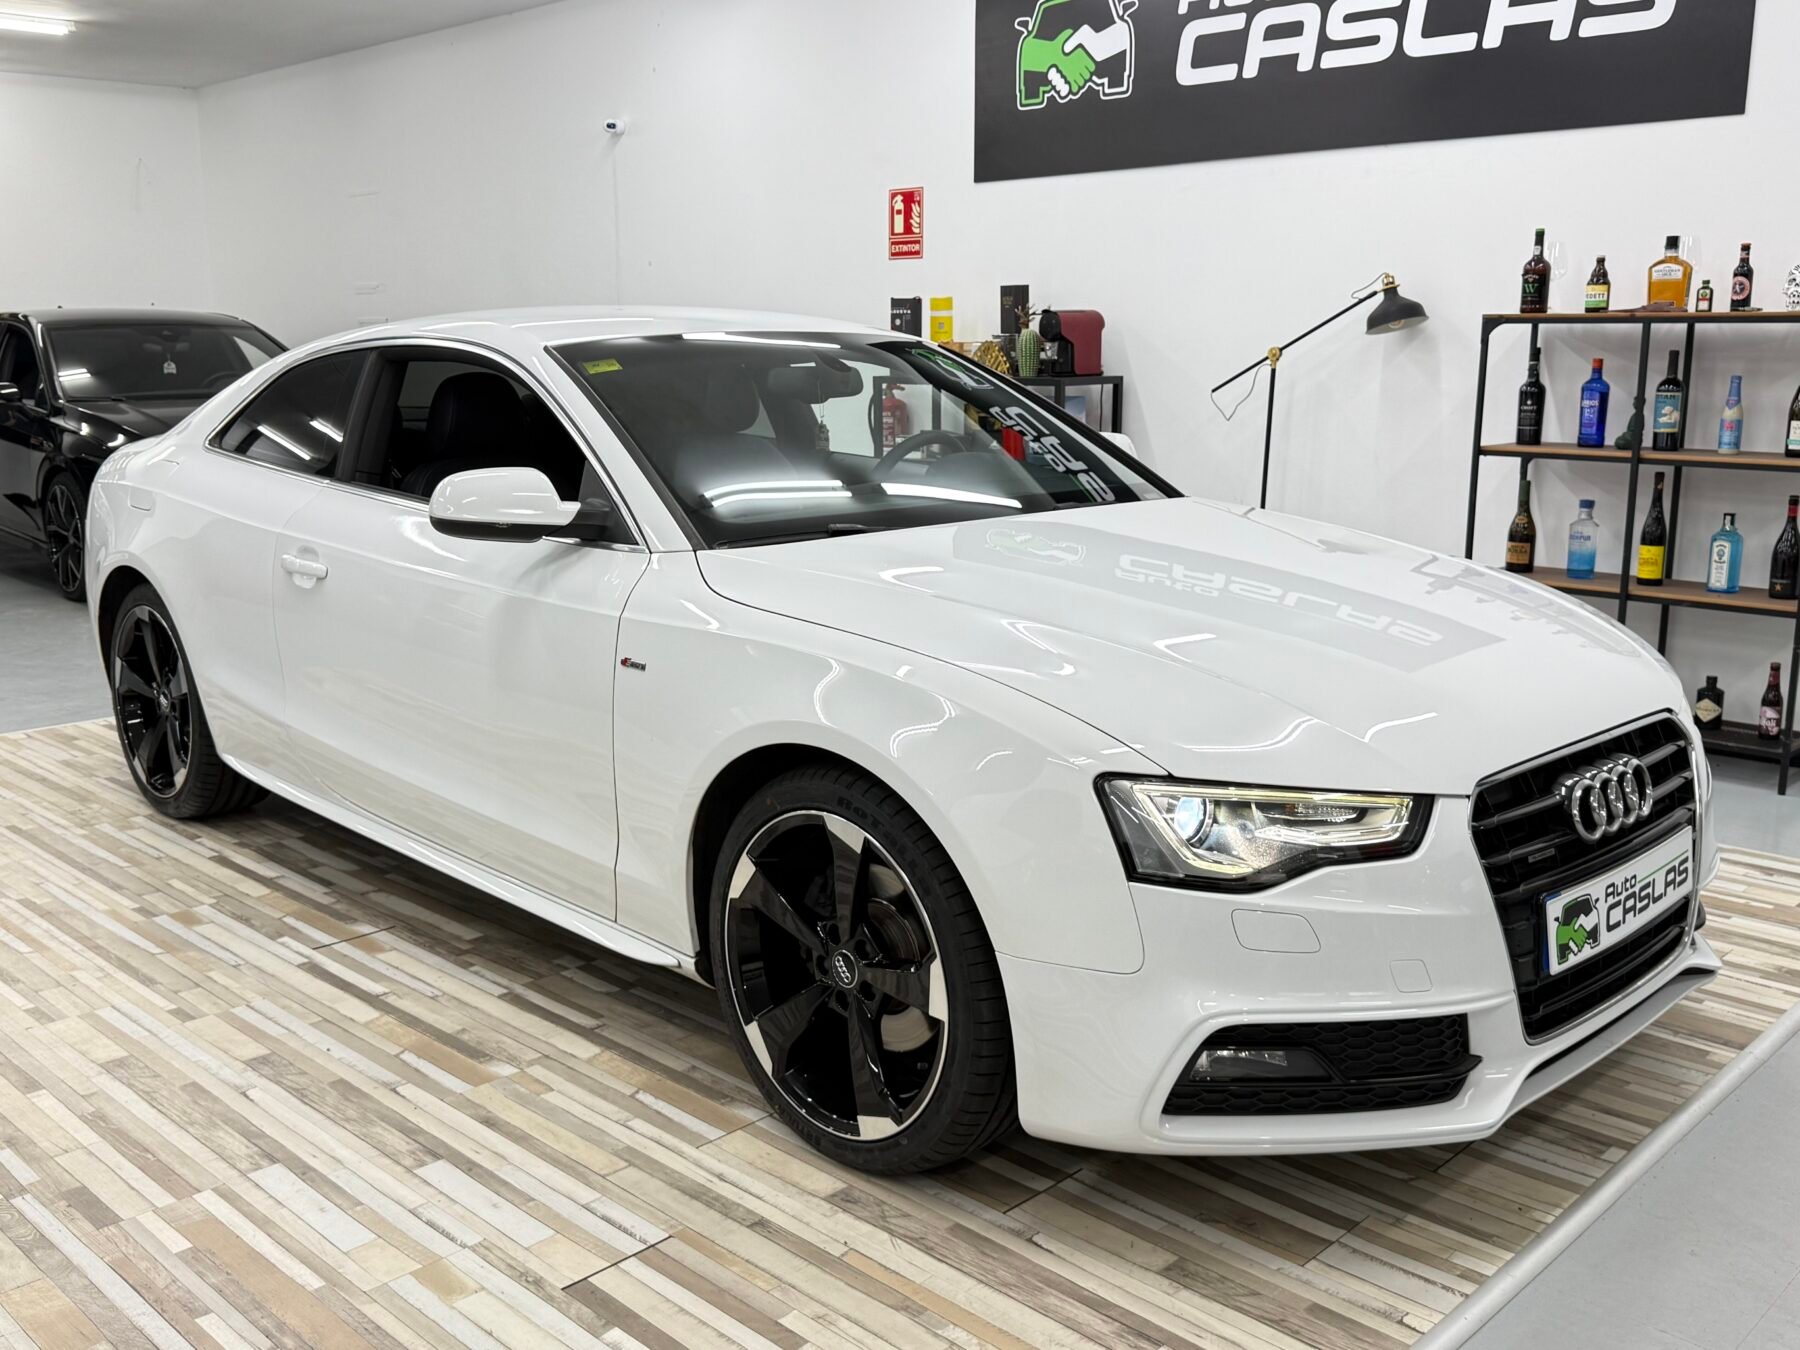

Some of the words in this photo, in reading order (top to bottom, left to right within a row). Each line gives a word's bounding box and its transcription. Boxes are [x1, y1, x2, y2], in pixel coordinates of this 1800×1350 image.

[891, 244, 920, 253] EXTINTOR
[1585, 292, 1606, 300] EDETT
[1605, 874, 1637, 903] Auto
[1606, 856, 1689, 933] CASLAS
